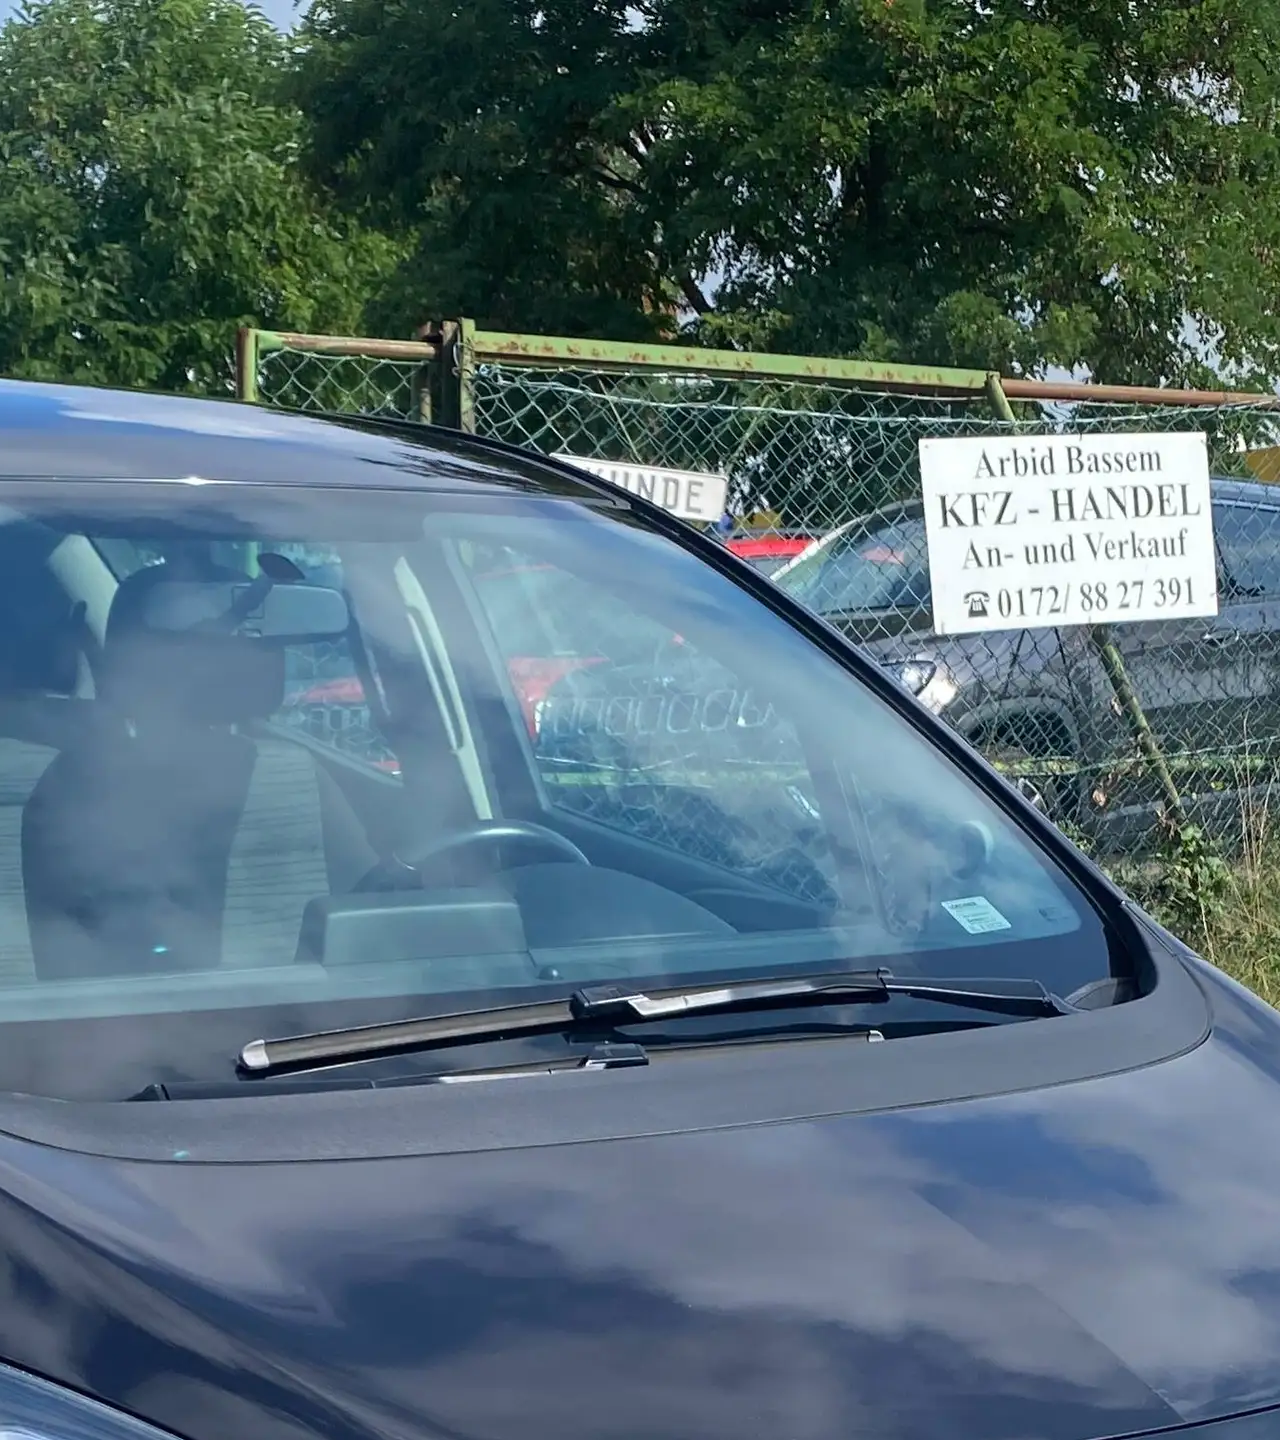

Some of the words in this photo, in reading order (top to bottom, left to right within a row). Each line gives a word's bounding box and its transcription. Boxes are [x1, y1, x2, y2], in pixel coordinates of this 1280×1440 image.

[974, 447, 1056, 479] Arbid
[1065, 446, 1162, 475] Bassem
[938, 490, 1018, 529] KFZ
[1051, 482, 1201, 523] HANDEL
[962, 540, 1014, 570] An-
[1024, 533, 1075, 565] und
[1083, 528, 1189, 561] Verkauf
[997, 583, 1071, 619] 0172/
[1079, 582, 1109, 612] 88
[1118, 580, 1144, 609] 27
[1153, 576, 1195, 607] 391
